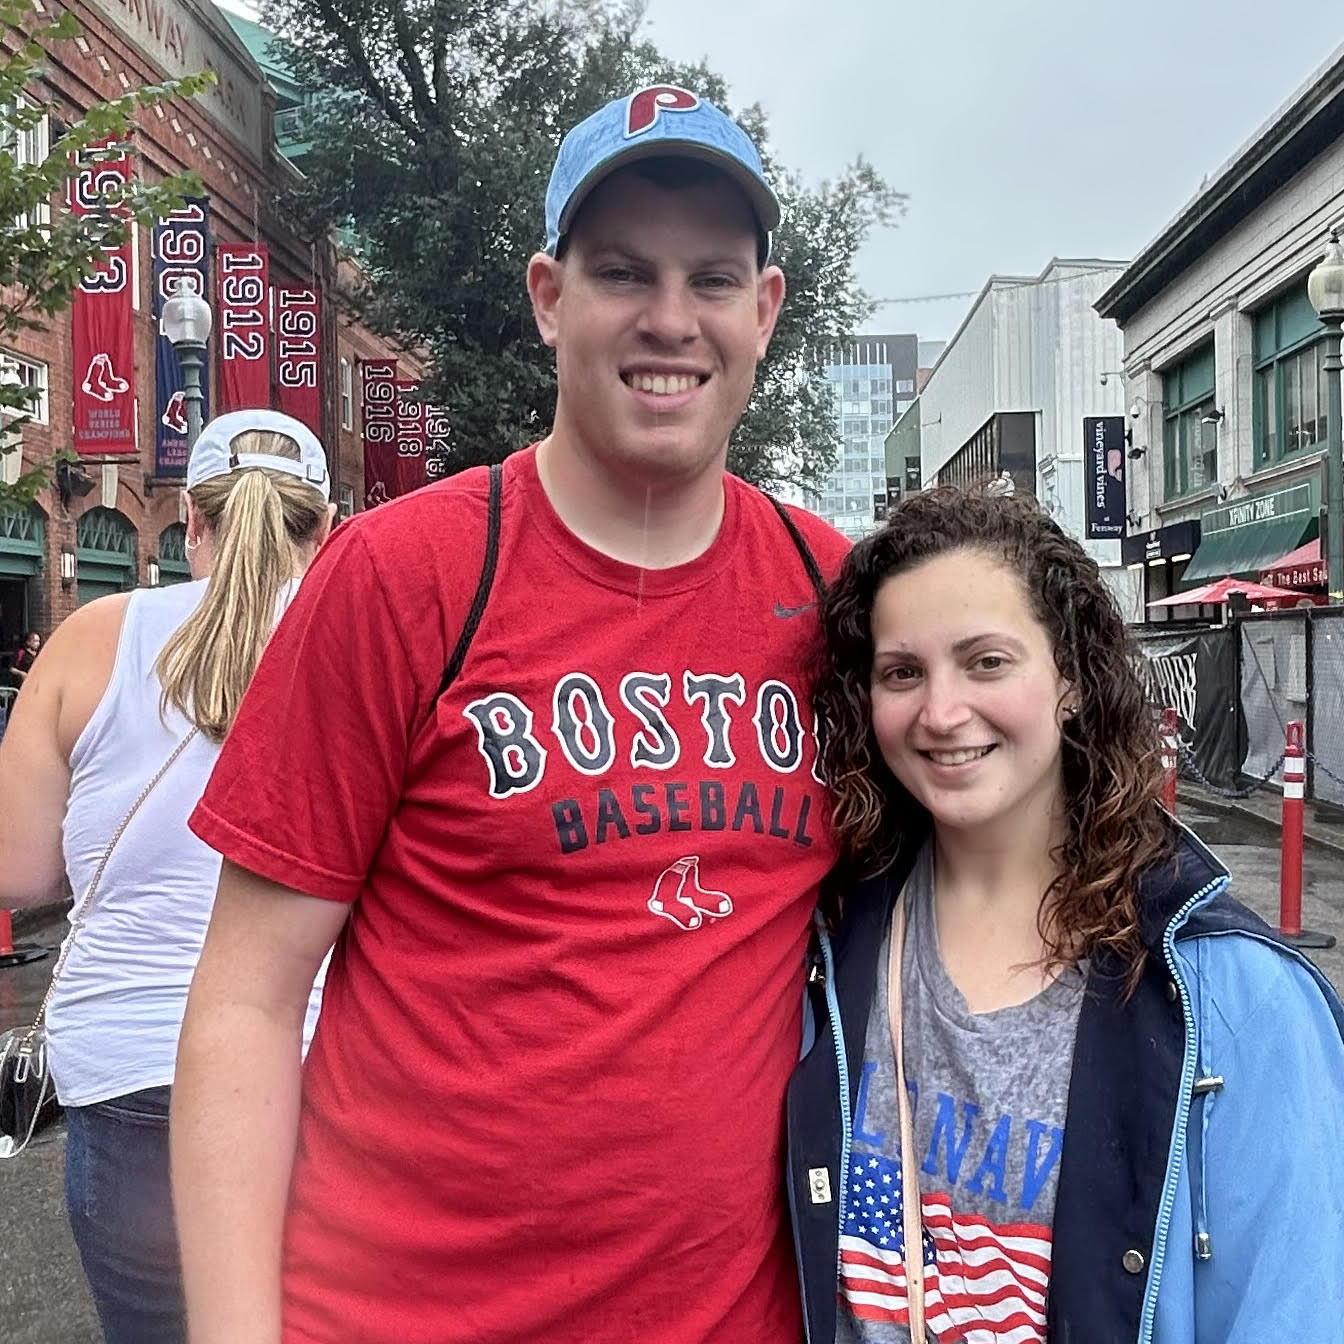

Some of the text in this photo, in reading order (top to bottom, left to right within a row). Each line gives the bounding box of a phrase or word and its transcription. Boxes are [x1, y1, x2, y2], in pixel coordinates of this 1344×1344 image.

[623, 83, 701, 140] P
[75, 141, 127, 293] 193
[159, 203, 205, 336] 190
[223, 253, 264, 360] 1912
[280, 290, 317, 388] 1915
[88, 408, 121, 418] WORLD
[365, 365, 395, 443] 1916
[397, 384, 424, 458] 1918
[1093, 421, 1108, 509] vineyard vines
[1091, 522, 1123, 534] Fenway
[1229, 497, 1275, 526] XFINITY ZONE
[1277, 573, 1291, 585] The
[1293, 570, 1311, 584] Best
[462, 669, 828, 800] BOSTO
[550, 780, 815, 855] BASEBALL
[921, 1091, 1066, 1211] NAV
